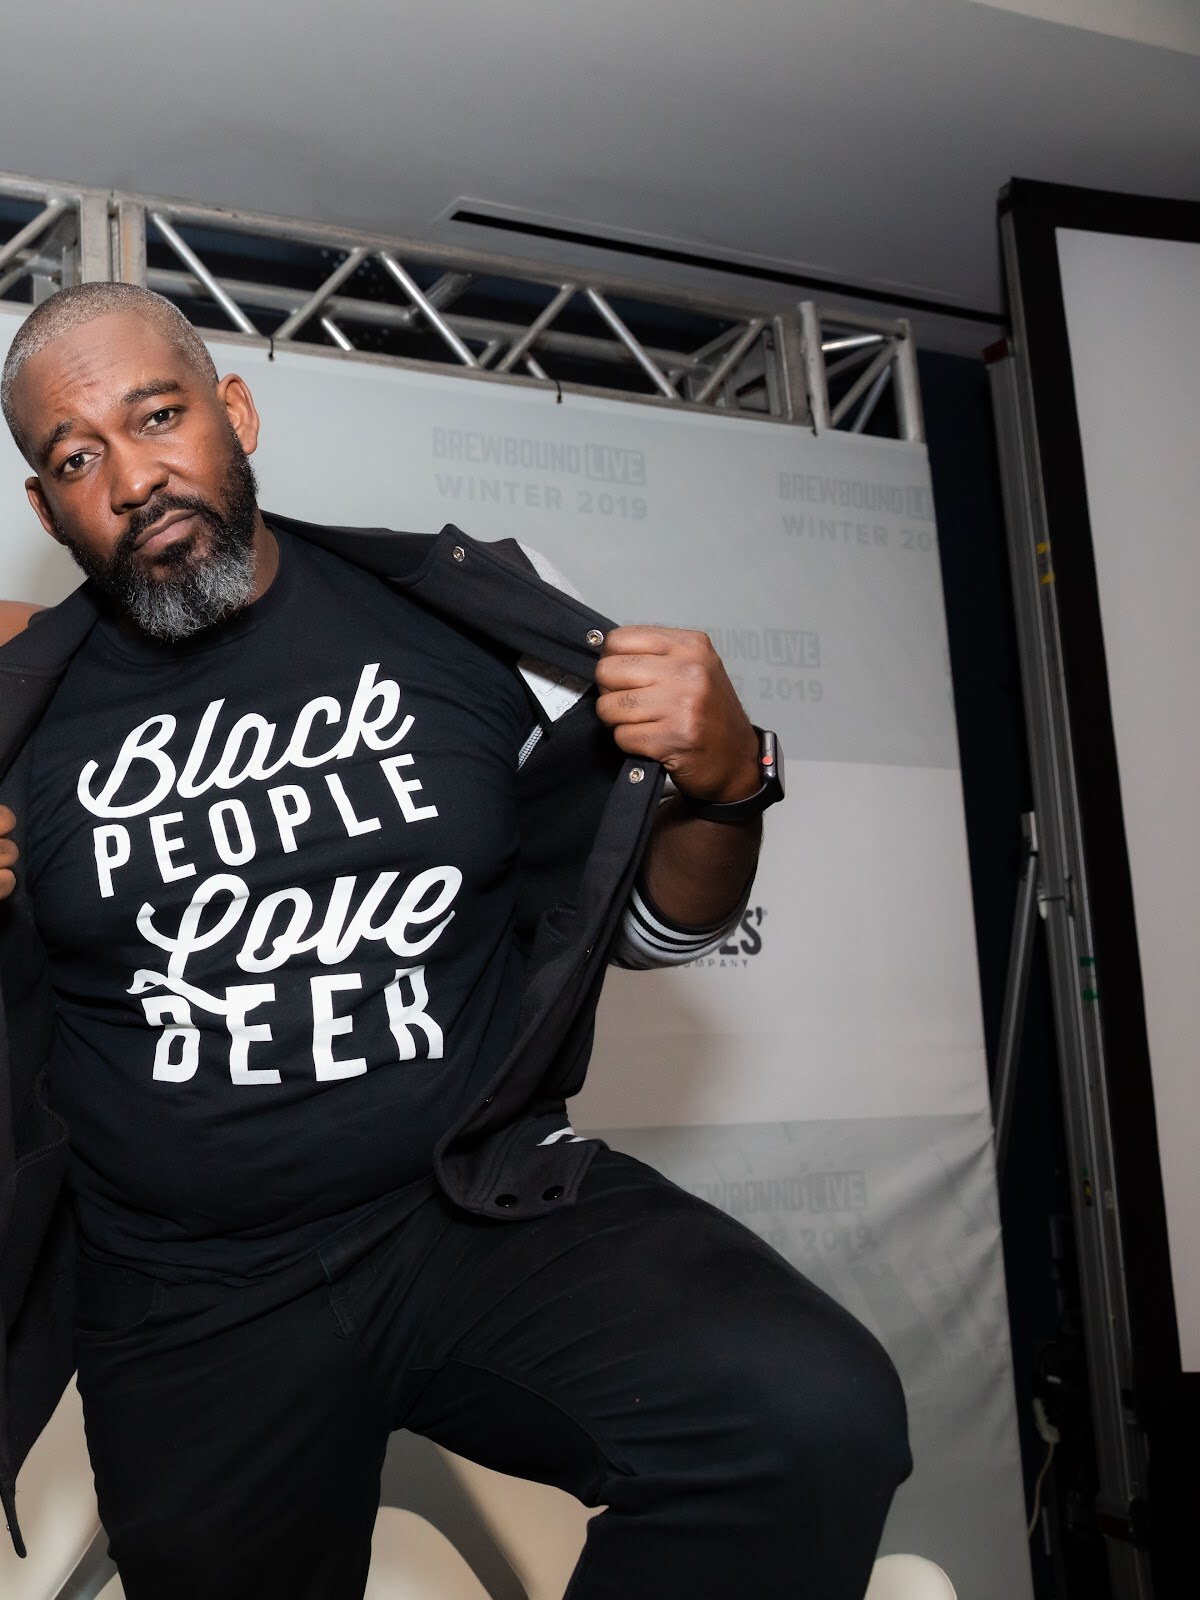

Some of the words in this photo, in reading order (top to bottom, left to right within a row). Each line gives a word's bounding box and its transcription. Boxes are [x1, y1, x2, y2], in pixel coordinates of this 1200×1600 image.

[432, 426, 580, 474] BREWBOUND
[587, 446, 646, 486] LIVE
[434, 473, 562, 510] WINTER
[577, 490, 648, 520] 2019
[778, 472, 903, 514] BREWBOUND
[780, 512, 888, 546] WINTER
[900, 528, 936, 552] 20
[767, 631, 819, 667] LIVE
[759, 676, 823, 702] 2019
[77, 663, 415, 818] Black
[93, 753, 438, 897] PEOPLE
[128, 865, 462, 1016] Love
[142, 965, 444, 1085] BEER
[808, 1173, 865, 1212] LIVE
